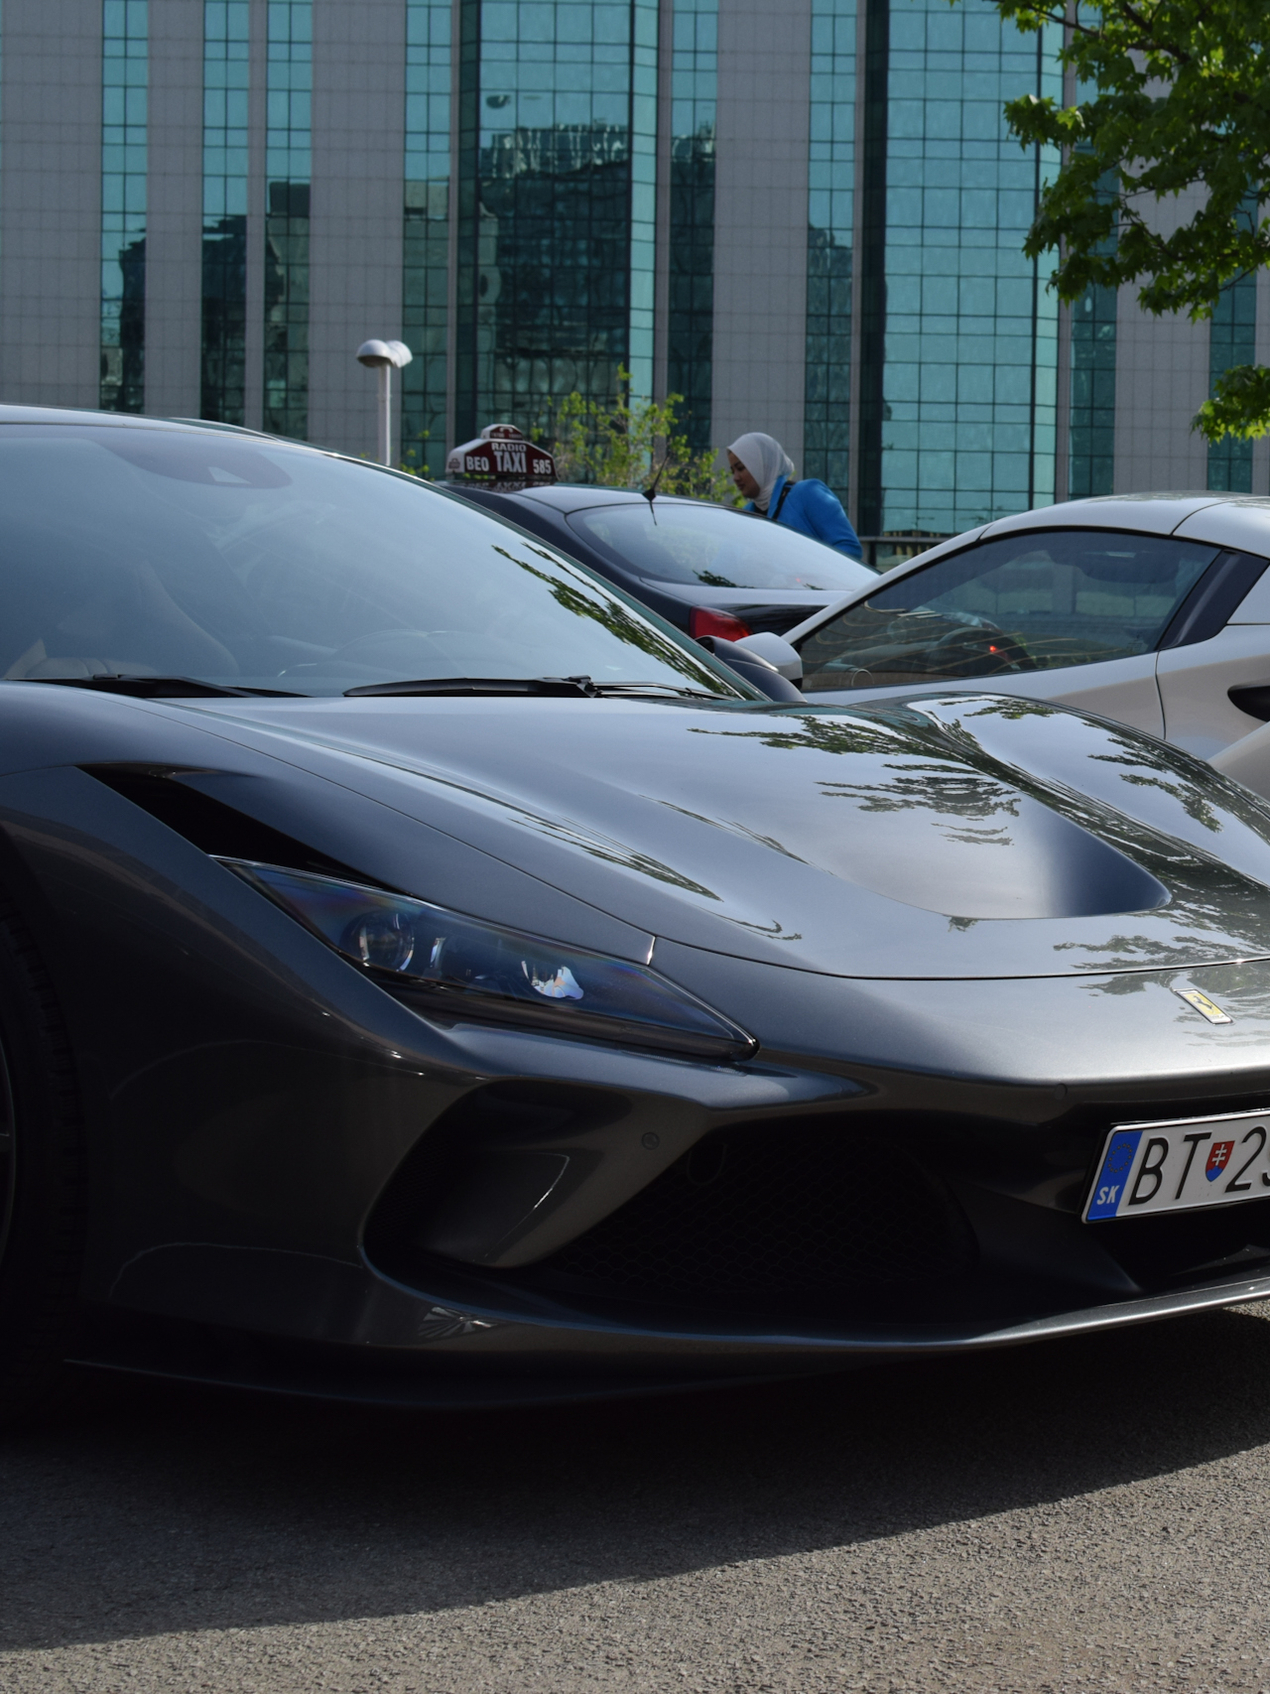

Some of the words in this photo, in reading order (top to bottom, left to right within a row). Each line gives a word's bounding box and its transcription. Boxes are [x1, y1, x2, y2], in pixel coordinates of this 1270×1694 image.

[491, 442, 527, 452] RADIO
[466, 456, 490, 472] BEO
[493, 451, 527, 473] TAXI
[533, 459, 551, 474] 585
[1128, 1131, 1212, 1206] BT
[1097, 1185, 1120, 1205] SK
